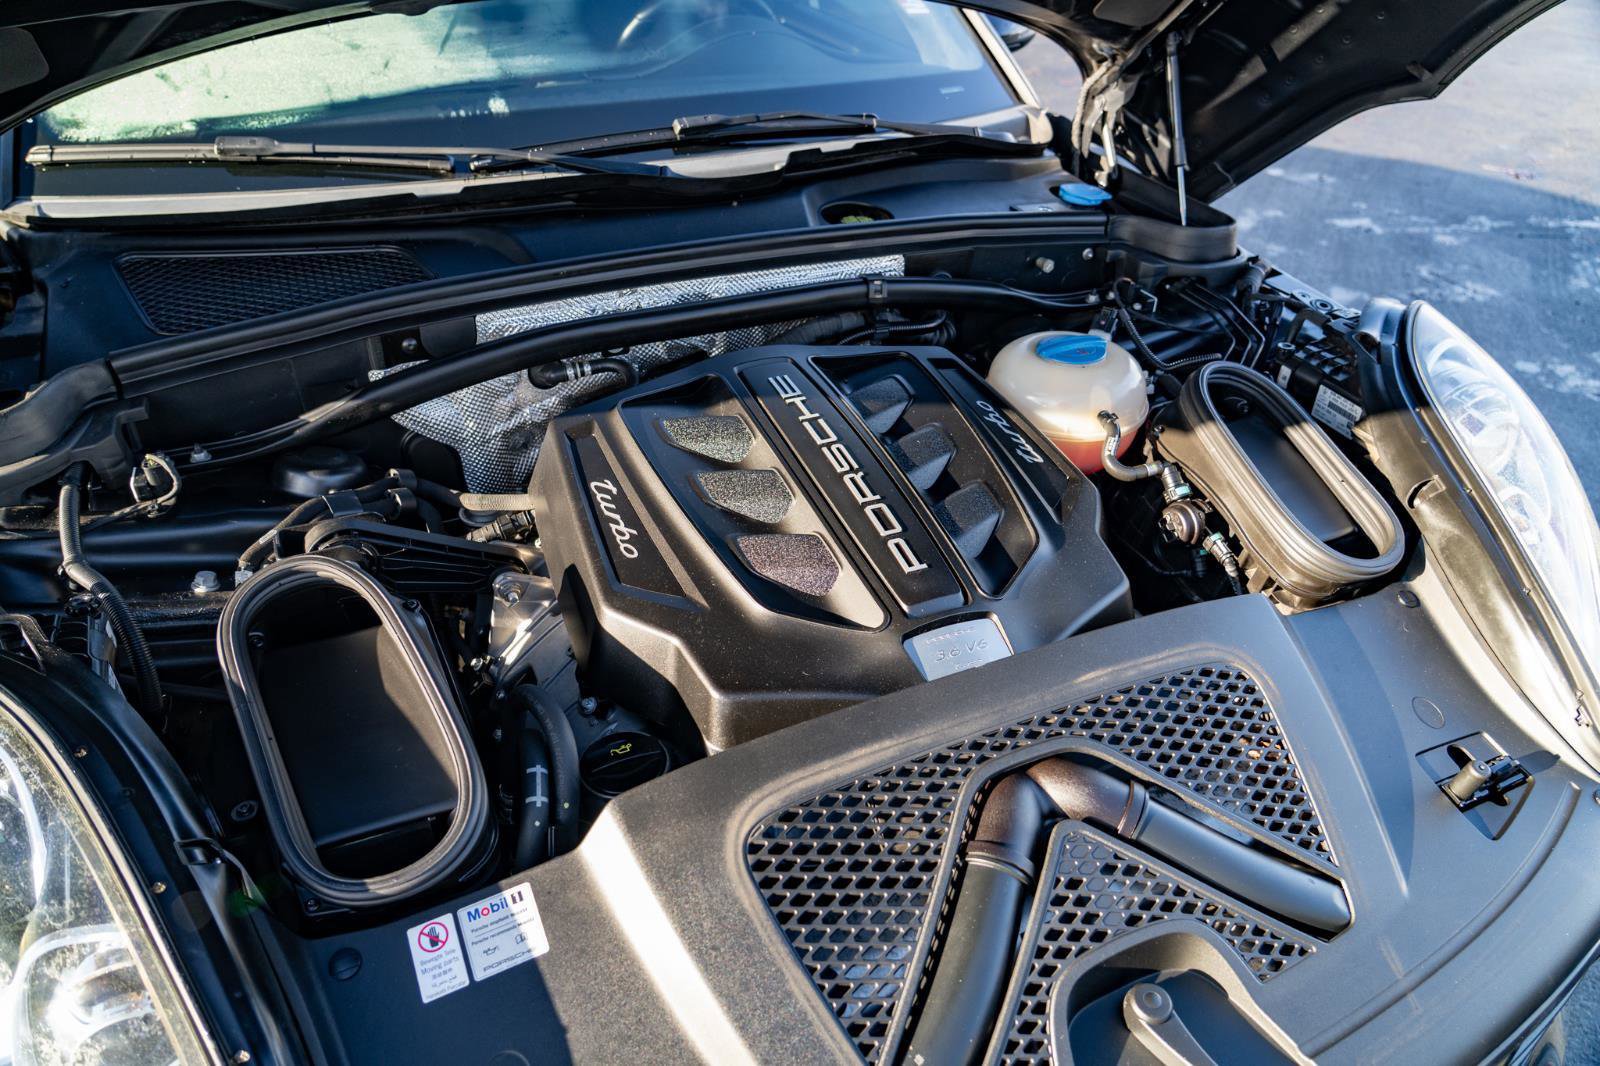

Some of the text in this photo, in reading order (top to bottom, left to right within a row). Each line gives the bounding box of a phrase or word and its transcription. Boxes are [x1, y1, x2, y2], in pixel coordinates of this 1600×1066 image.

[976, 400, 1044, 464] turbo
[768, 374, 928, 574] PORSCHE
[590, 479, 639, 559] turbo
[936, 638, 989, 662] 3.6 V6
[467, 897, 509, 922] Mobil
